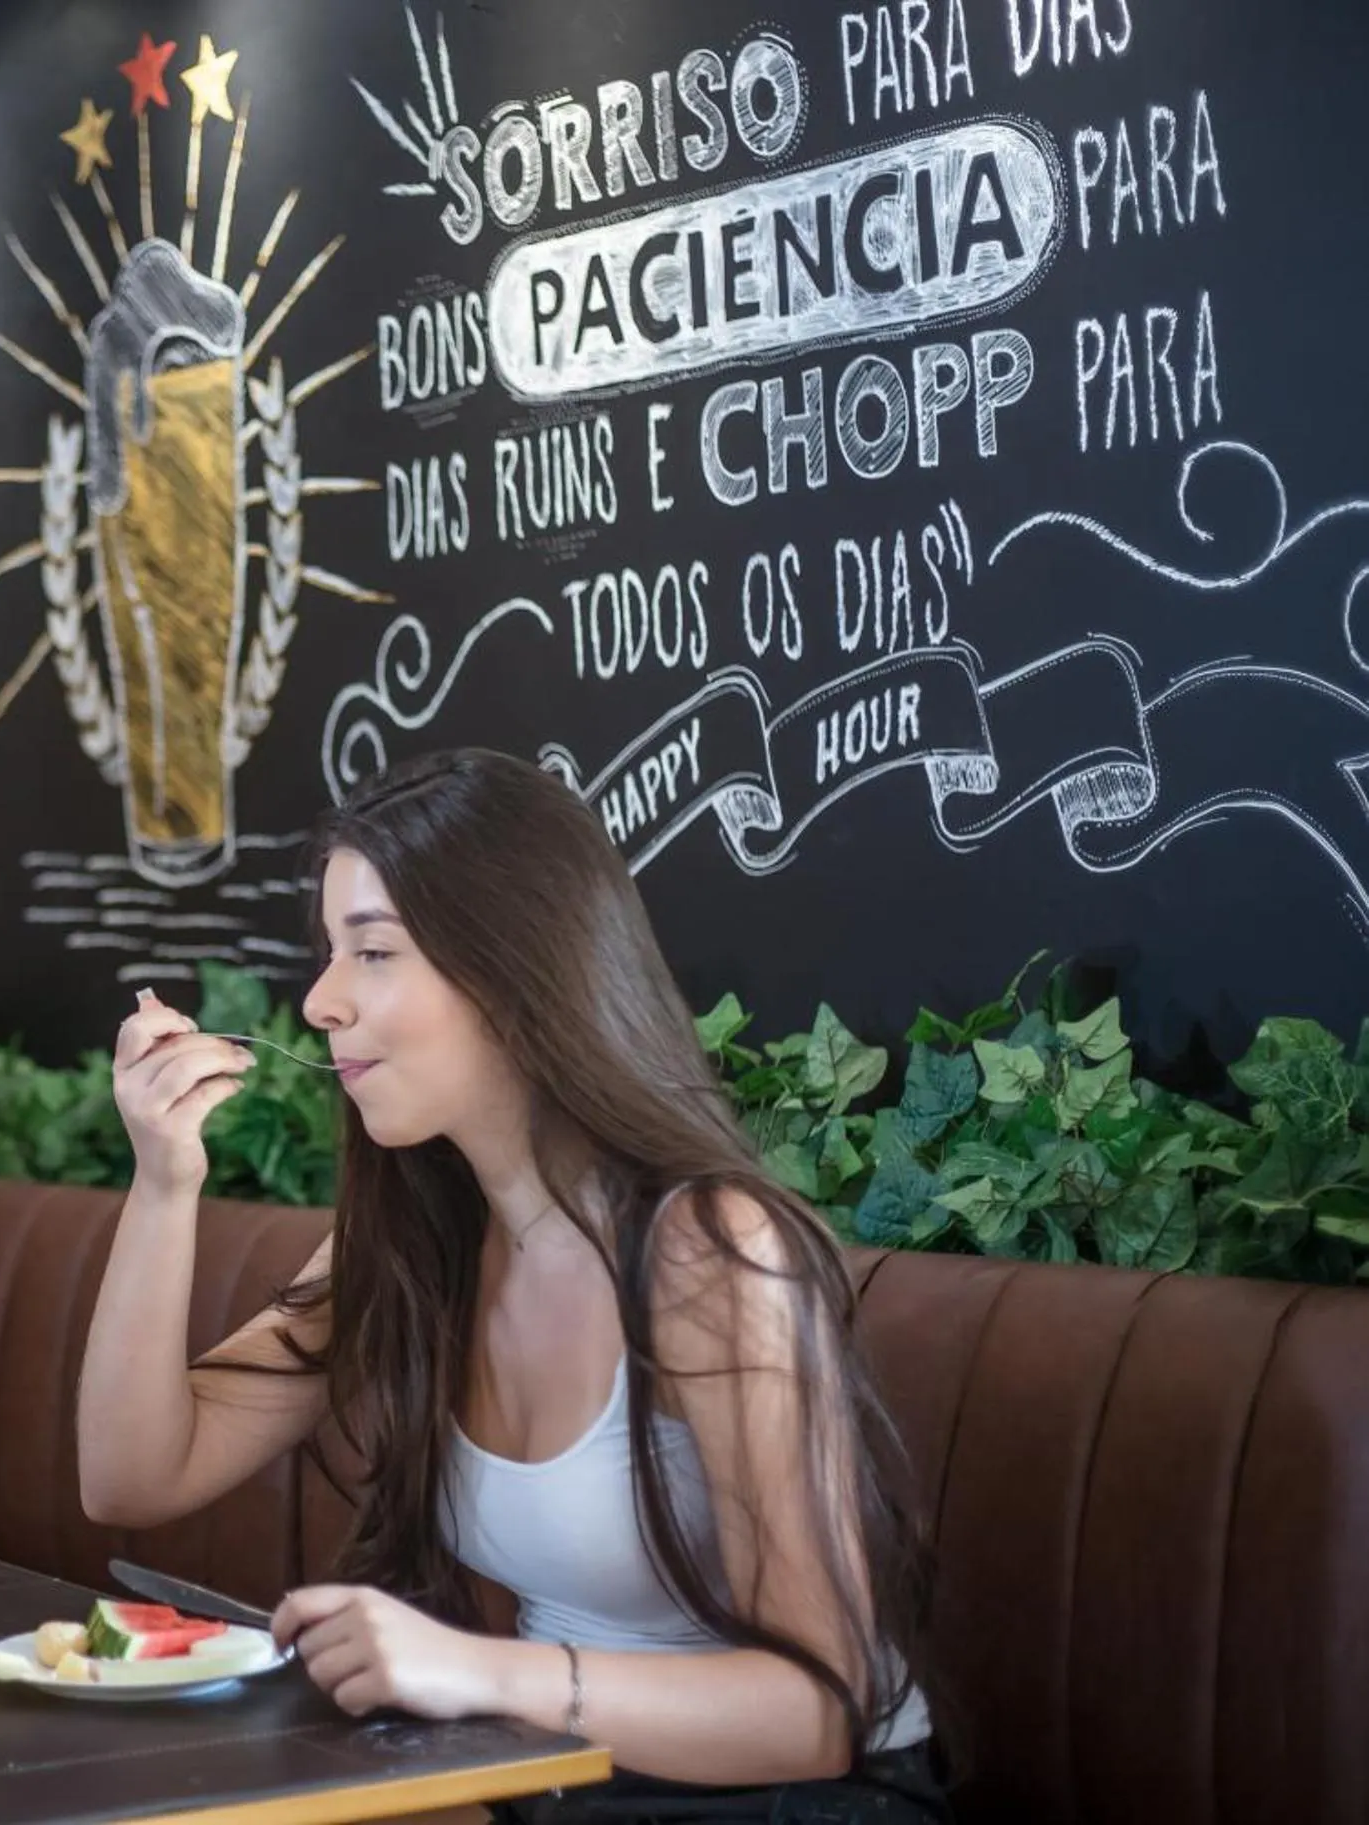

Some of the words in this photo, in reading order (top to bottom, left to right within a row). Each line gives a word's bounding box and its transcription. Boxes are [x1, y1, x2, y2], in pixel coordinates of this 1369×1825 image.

[439, 39, 801, 246] SORRISO
[840, 0, 975, 126] PARA
[377, 289, 488, 412] BONS
[1074, 89, 1227, 249] PARA
[385, 451, 471, 562] DIAS
[494, 413, 618, 541] RUINS
[647, 402, 675, 512] E
[700, 328, 1033, 506] CHOPP
[1075, 290, 1224, 452] PARA
[561, 559, 710, 681] TODOS
[742, 542, 804, 661] OS
[600, 717, 701, 847] HAPPY
[815, 683, 922, 784] HOUR
